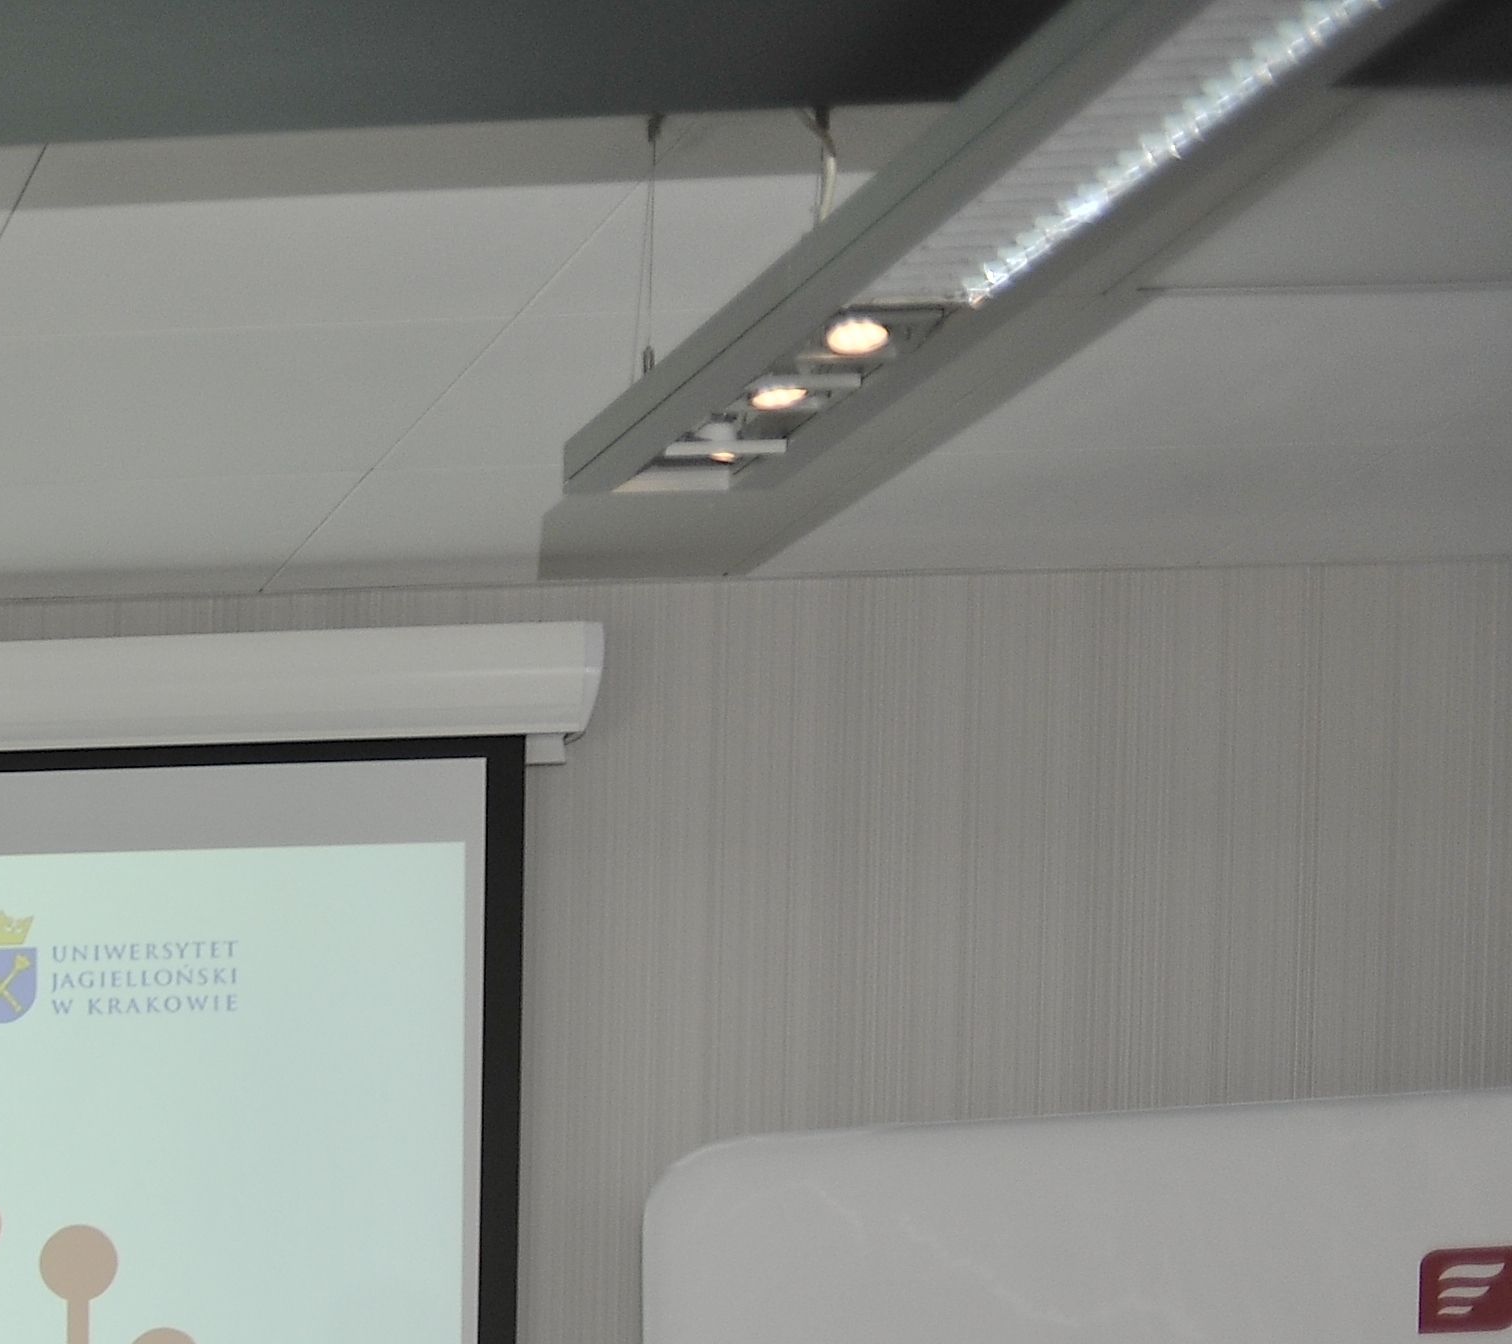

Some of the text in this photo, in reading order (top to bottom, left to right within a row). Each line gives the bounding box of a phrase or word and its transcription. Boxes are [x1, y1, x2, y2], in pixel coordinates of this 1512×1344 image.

[52, 941, 238, 963] UNIWERSYTET
[52, 964, 239, 993] JAGIELLOŃSKI
[52, 994, 238, 1015] W KRAKOWIE
